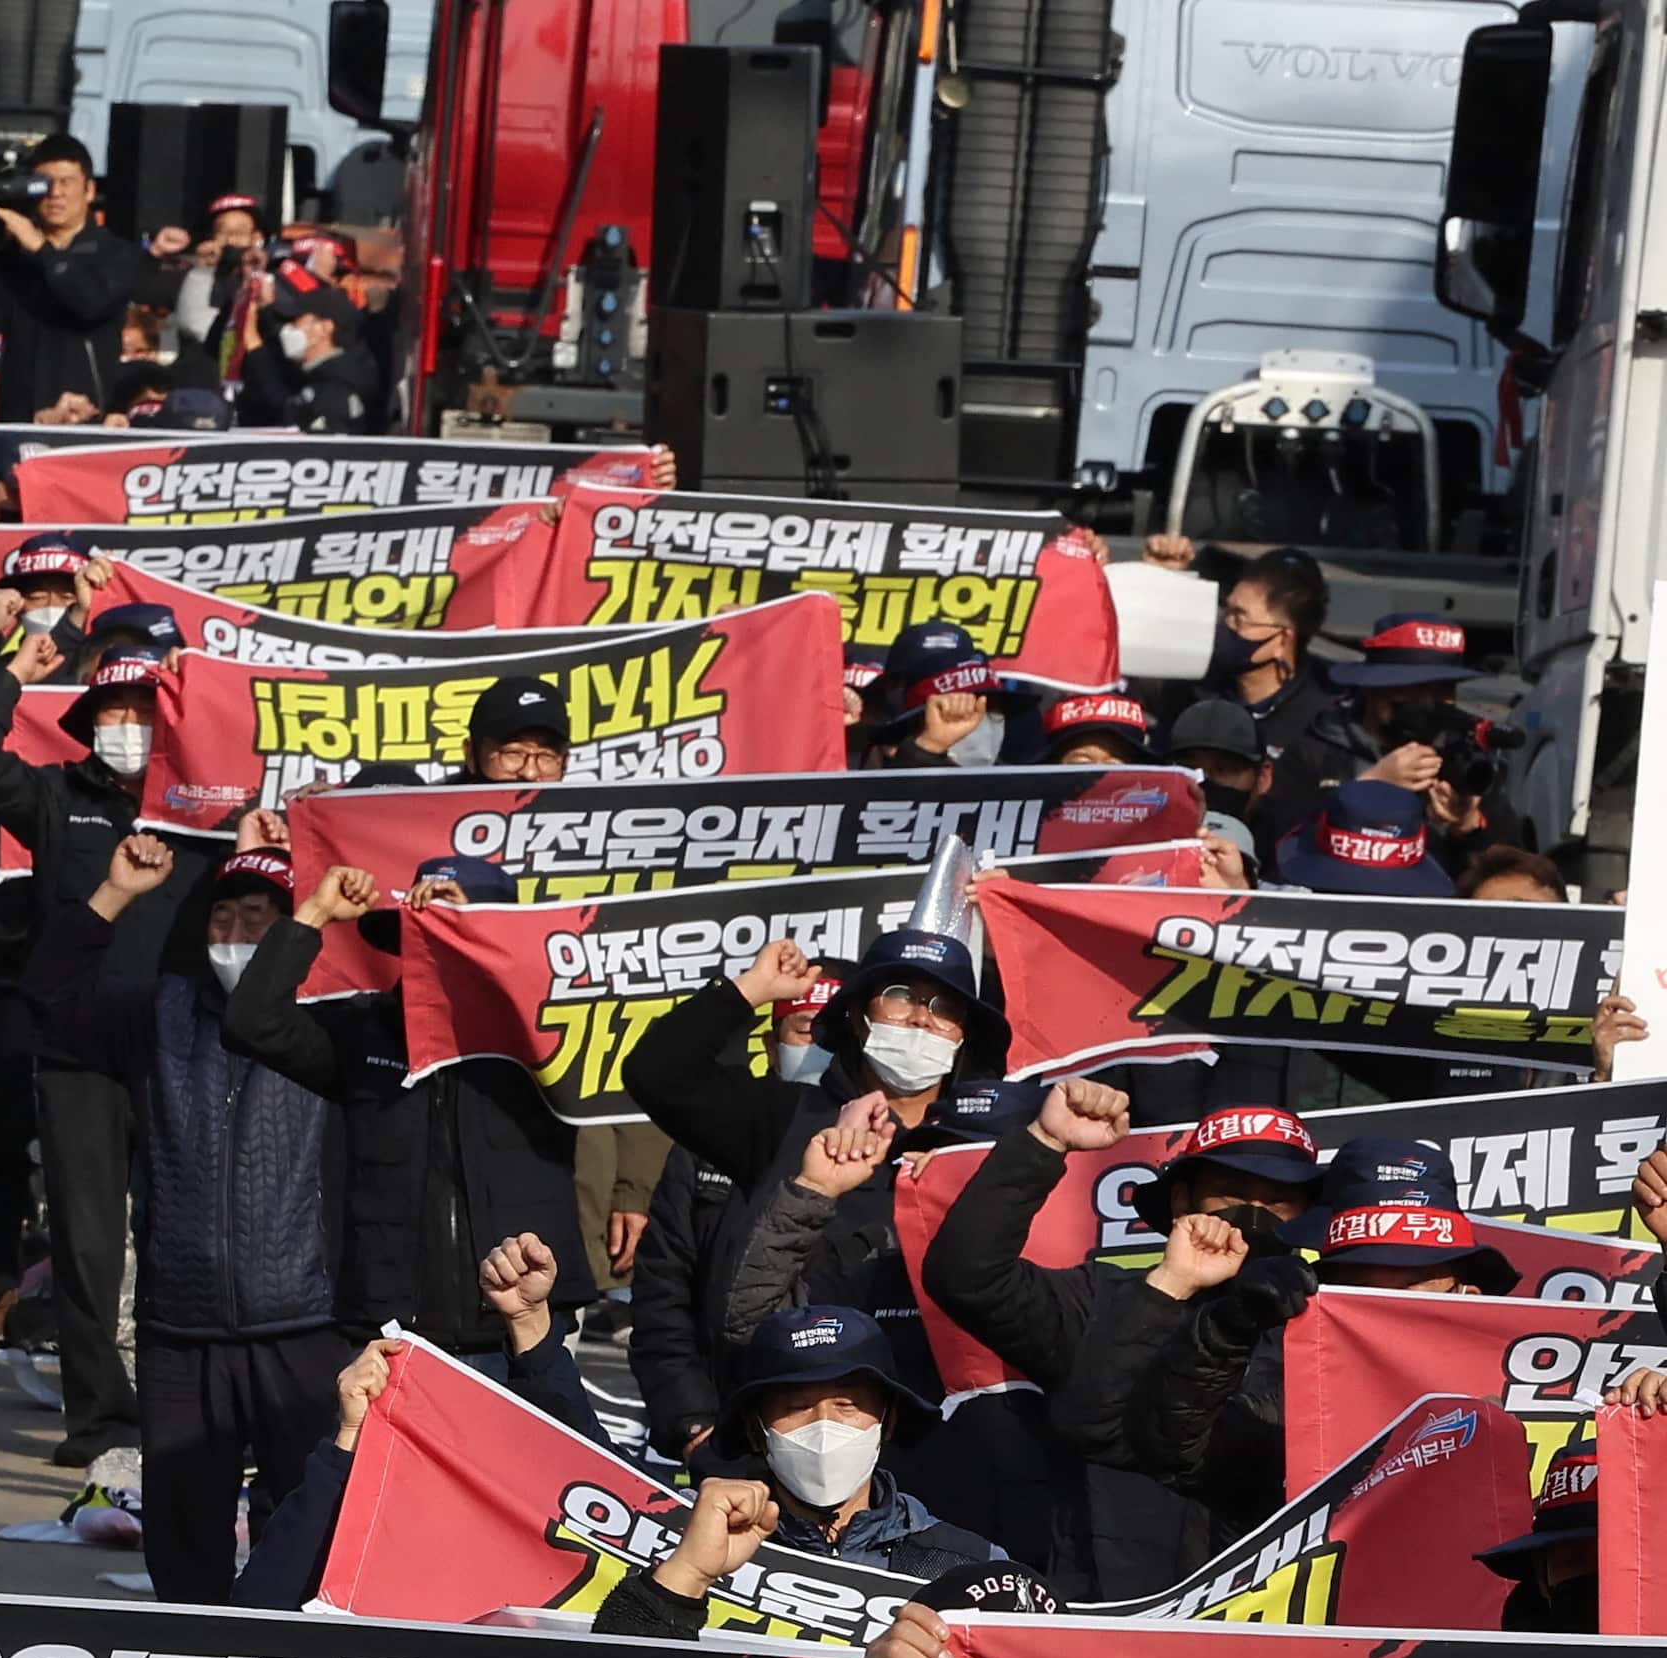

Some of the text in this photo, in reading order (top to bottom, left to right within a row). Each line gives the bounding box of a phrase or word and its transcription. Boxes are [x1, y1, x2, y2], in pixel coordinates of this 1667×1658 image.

[124, 460, 553, 514] 안전운임제 확대!
[311, 523, 456, 580] 확대!
[591, 502, 1045, 578] 안전운임제 확대!
[933, 671, 971, 694] 단결
[1061, 805, 1149, 824] 화물연대본부
[451, 804, 840, 874] 안전운임제
[1330, 833, 1372, 859] 단결
[1196, 1119, 1313, 1153] 단결 투쟁
[1329, 1213, 1453, 1246] 단결 투쟁
